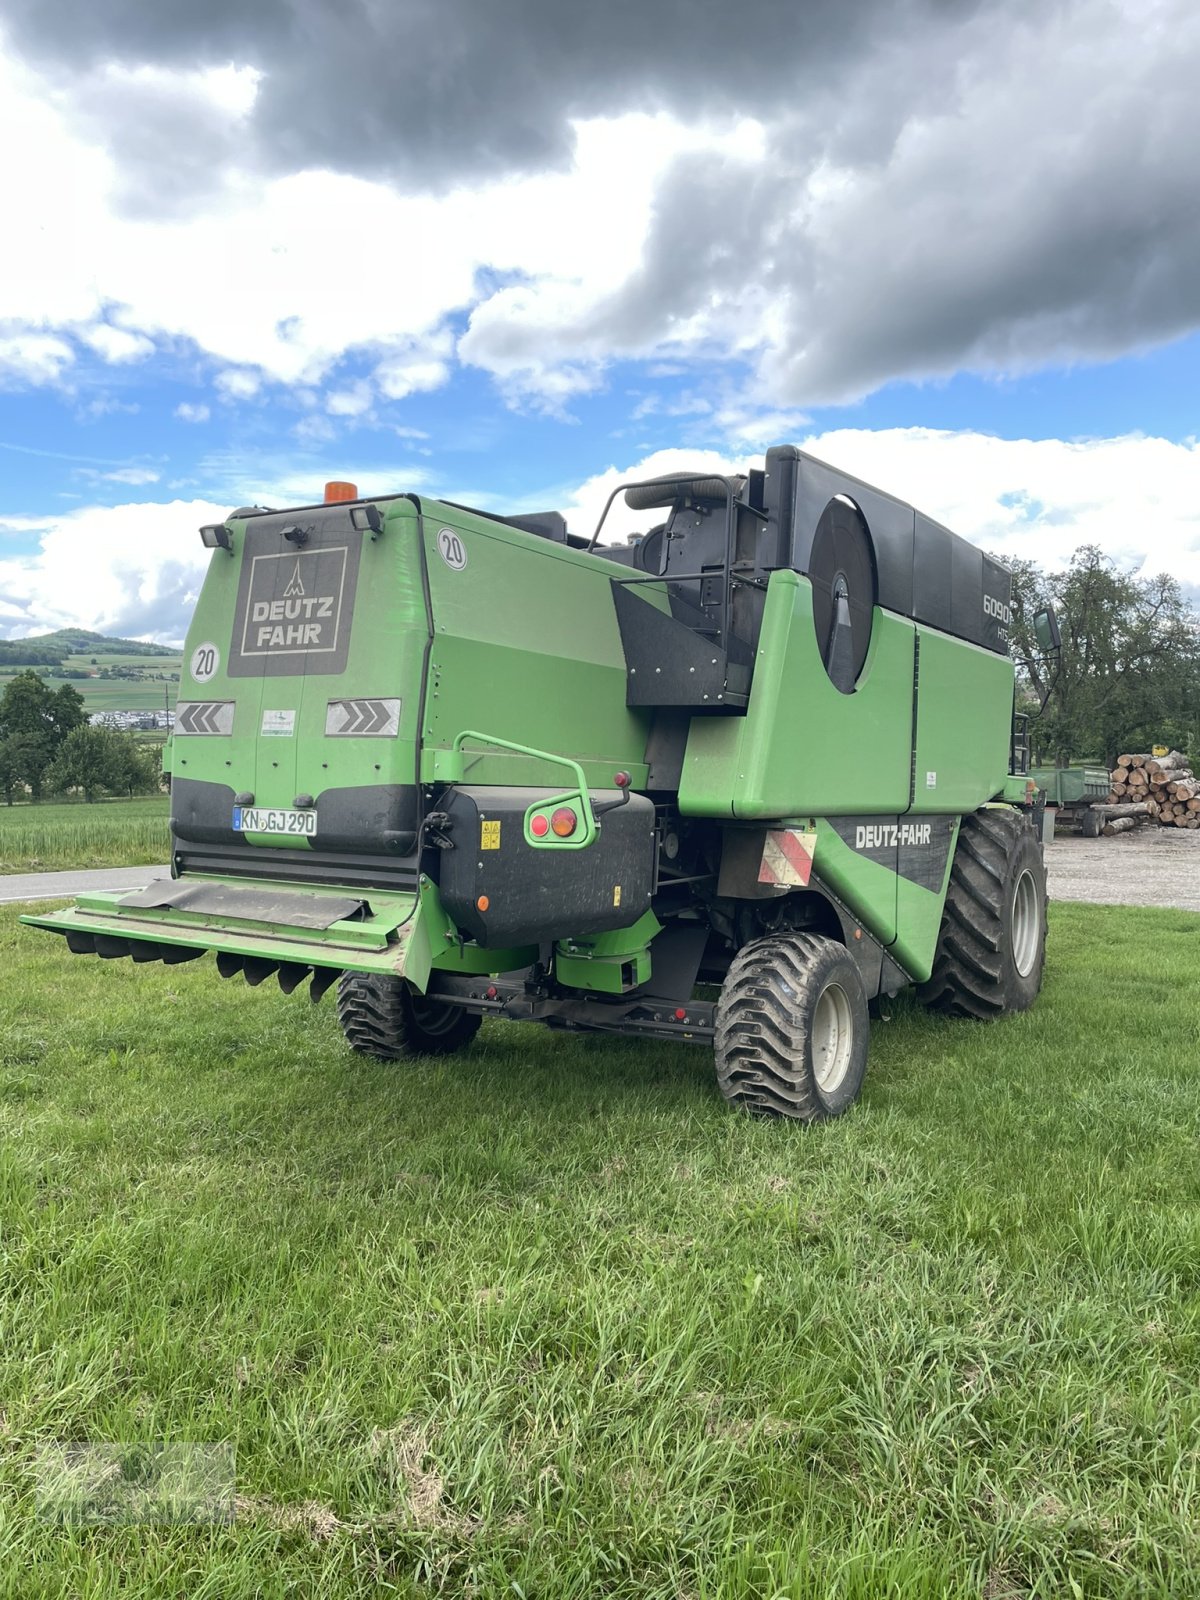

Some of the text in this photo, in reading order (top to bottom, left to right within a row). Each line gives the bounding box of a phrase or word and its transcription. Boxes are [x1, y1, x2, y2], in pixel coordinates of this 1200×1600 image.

[442, 534, 463, 564] 20
[252, 596, 334, 622] DEUTZ
[983, 593, 1009, 624] 6090
[256, 623, 322, 647] FAHR
[195, 649, 215, 675] 20
[855, 824, 931, 849] DEUTZ-FAHR
